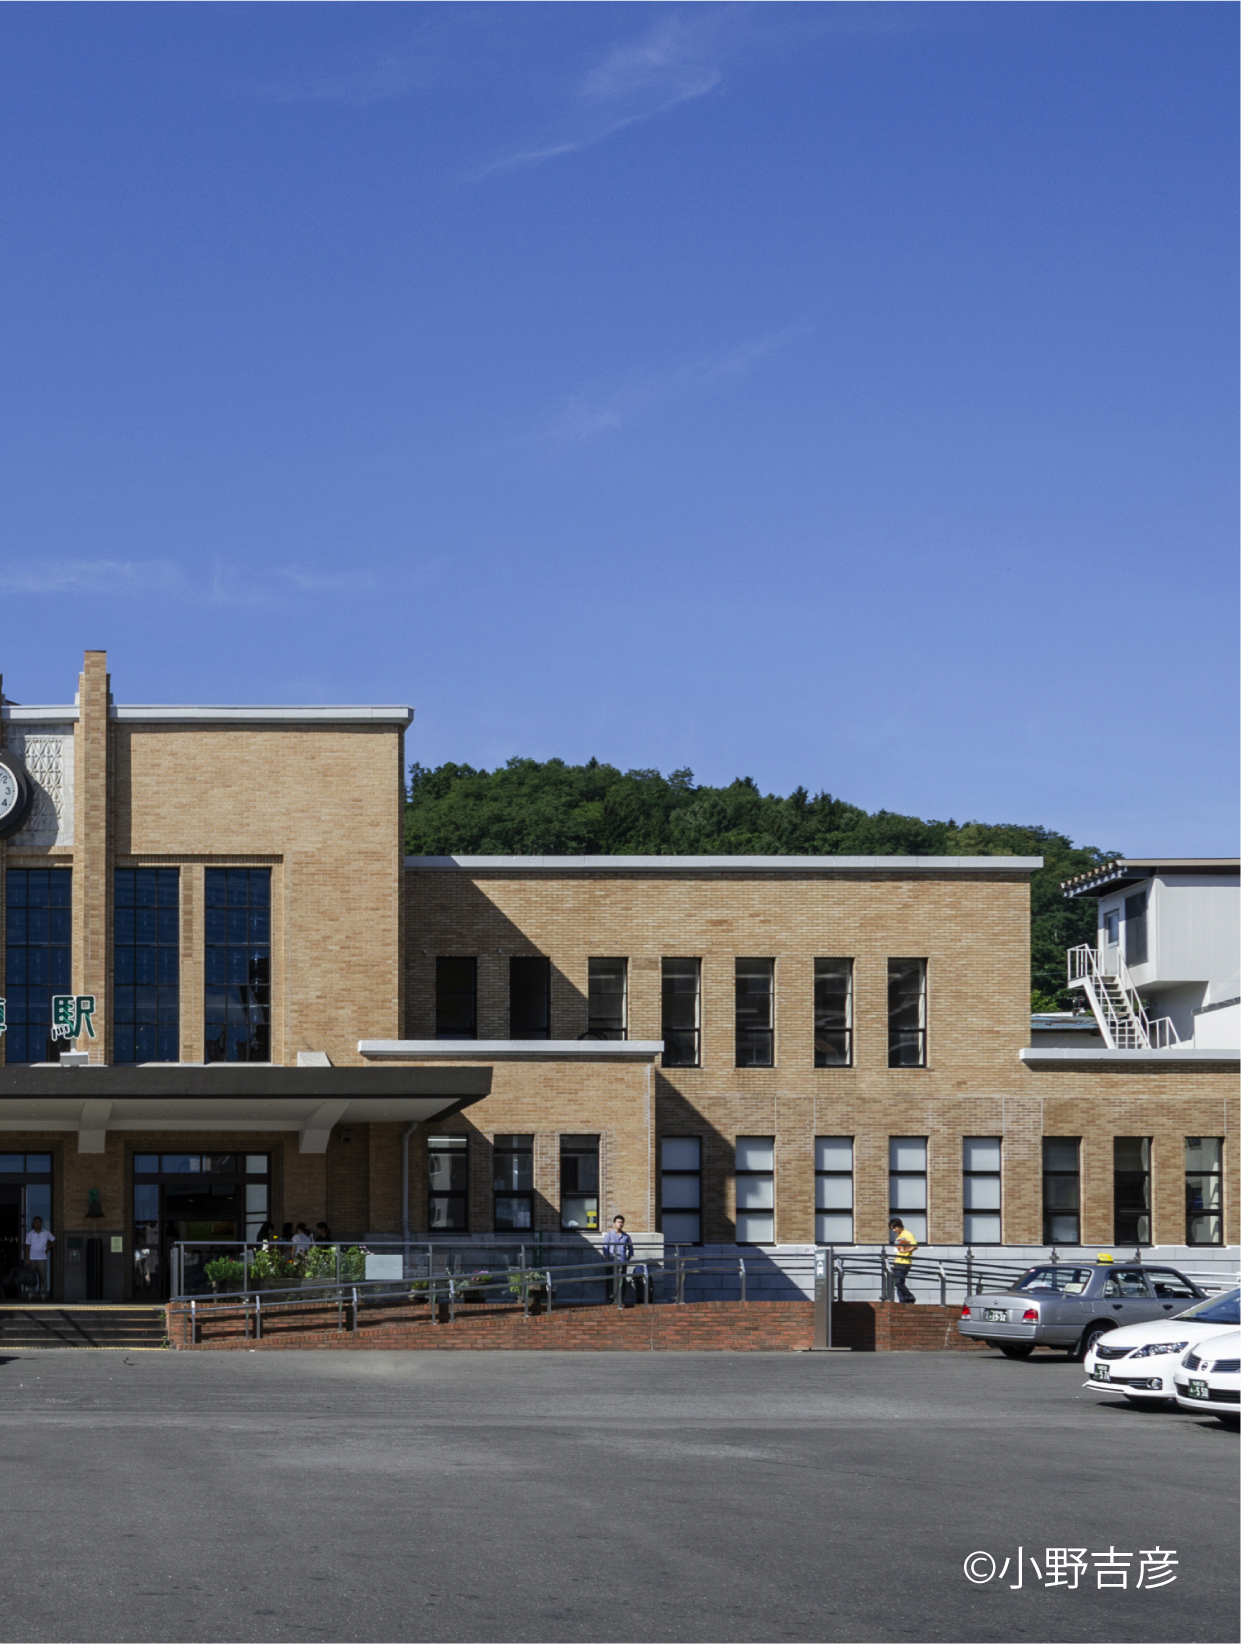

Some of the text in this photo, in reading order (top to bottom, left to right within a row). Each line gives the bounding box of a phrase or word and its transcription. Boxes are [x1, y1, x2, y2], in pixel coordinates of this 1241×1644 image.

[2, 775, 8, 784] 2
[5, 786, 11, 795] 3
[1, 798, 8, 807] 4
